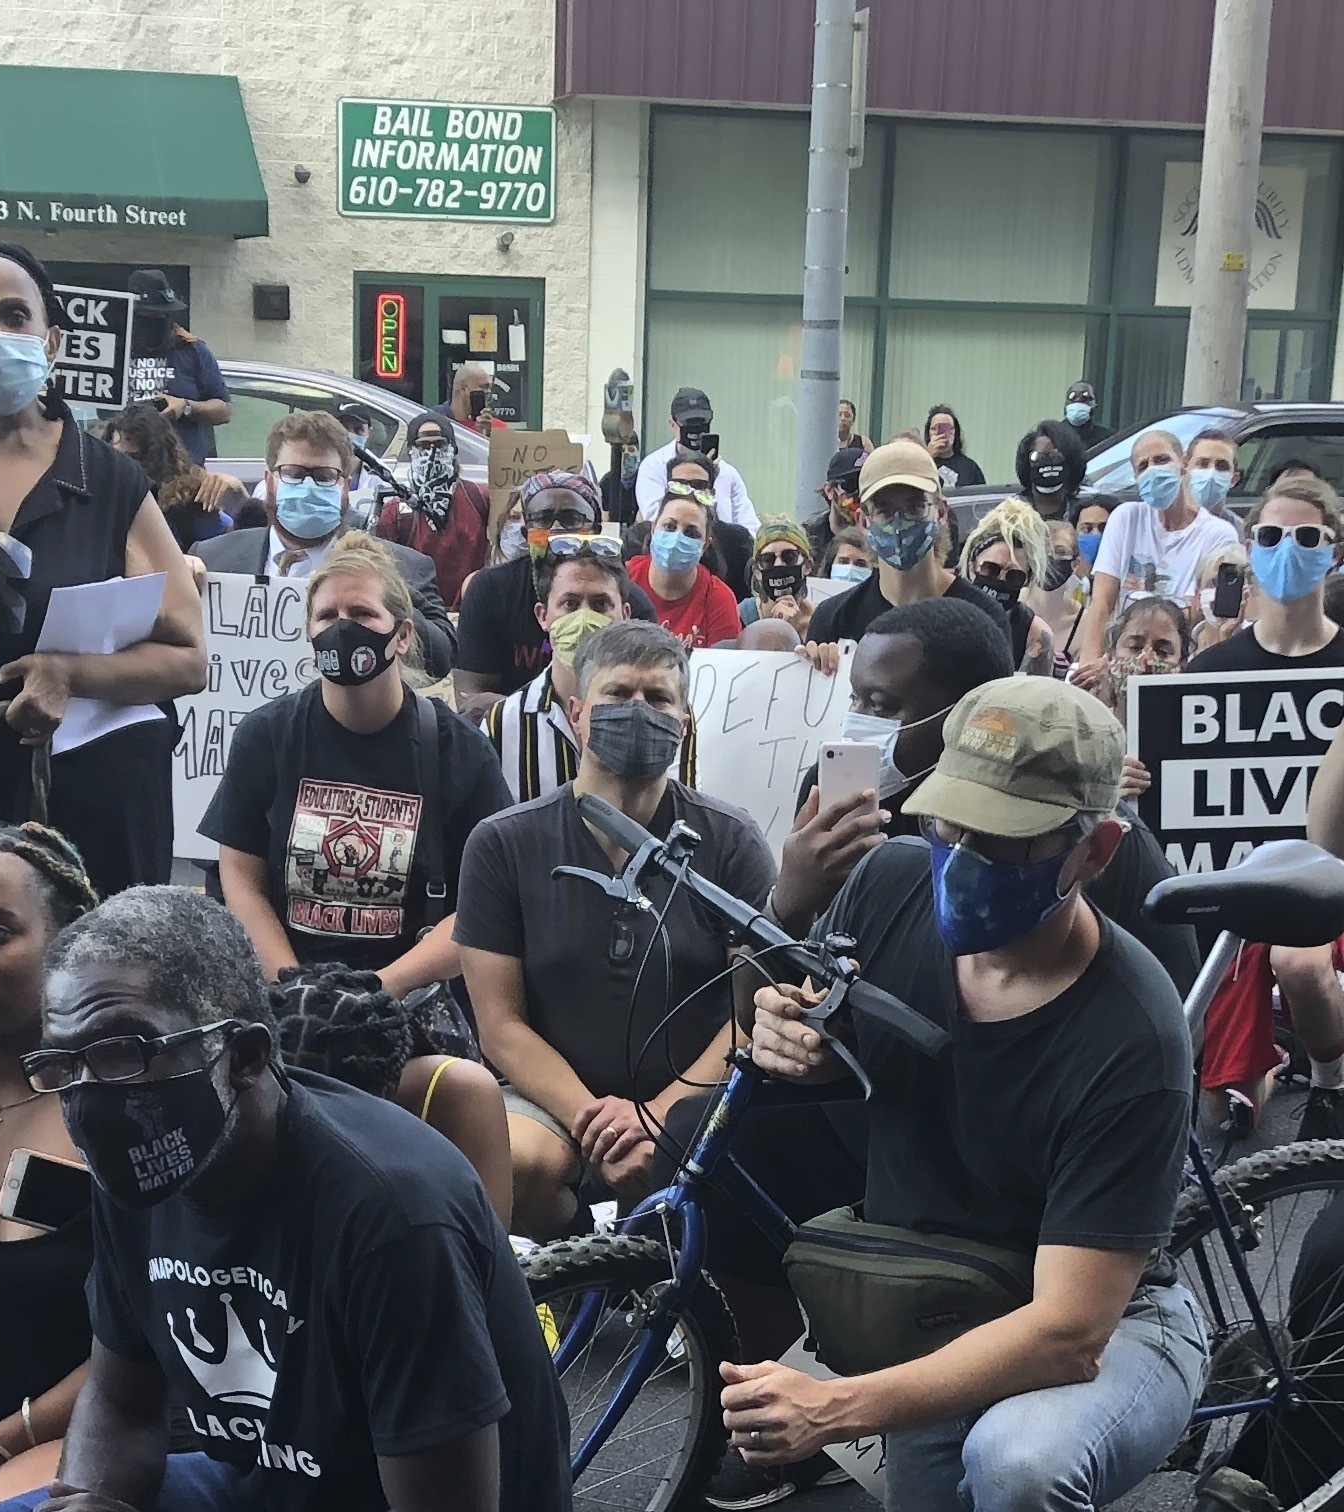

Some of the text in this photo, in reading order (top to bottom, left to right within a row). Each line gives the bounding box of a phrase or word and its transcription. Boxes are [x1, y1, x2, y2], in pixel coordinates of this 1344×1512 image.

[372, 106, 523, 141] BAIL BOND
[351, 138, 544, 175] INFORMATION
[348, 175, 546, 212] 610-782-9770
[16, 200, 41, 222] N.
[49, 201, 118, 224] Fourth
[125, 204, 187, 226] Street
[381, 300, 399, 372] OPEN
[128, 367, 176, 379] USTICE
[511, 445, 548, 464] NO
[687, 659, 838, 734] DEFU
[363, 794, 417, 824] STUDENTS
[292, 899, 399, 935] BLACK LIVES
[127, 1126, 187, 1165] BLACK
[134, 1144, 192, 1179] LIVES
[138, 1157, 195, 1193] MATTER
